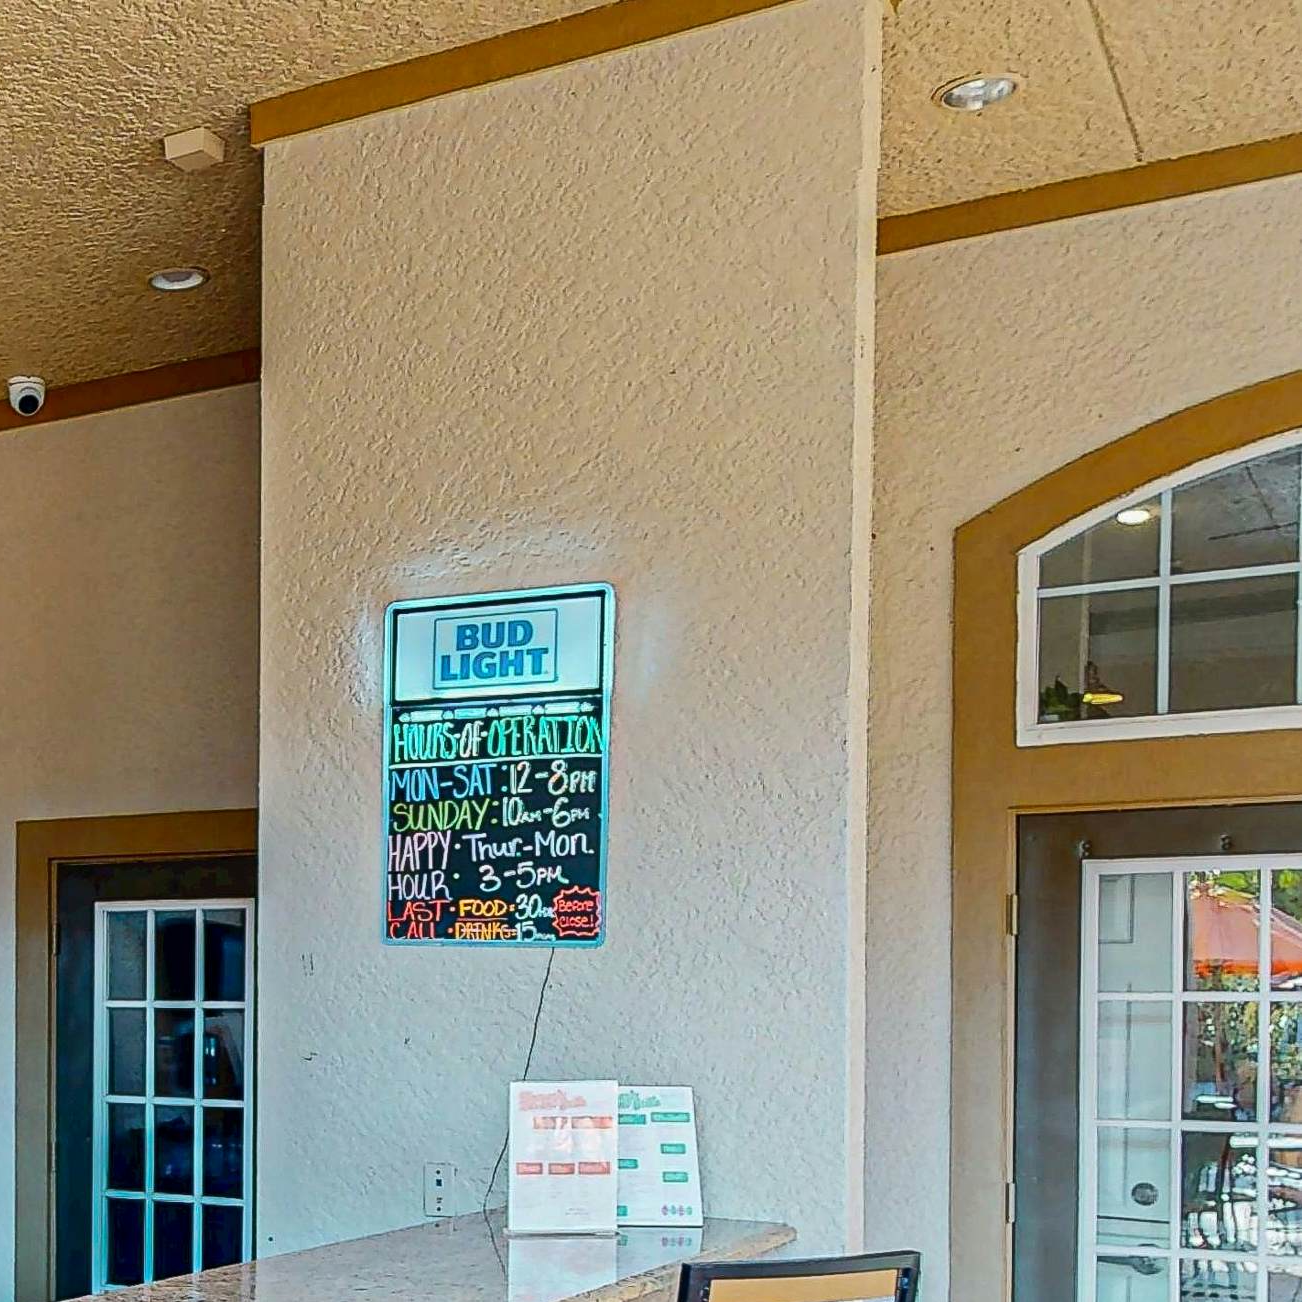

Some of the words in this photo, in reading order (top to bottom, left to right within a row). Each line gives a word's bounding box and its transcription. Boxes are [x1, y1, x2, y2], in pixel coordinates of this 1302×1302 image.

[456, 619, 534, 651] BUD
[440, 647, 549, 682] LIGHT
[387, 830, 452, 872] HAPPY
[387, 869, 453, 901] HOUR
[387, 900, 450, 922] LAST
